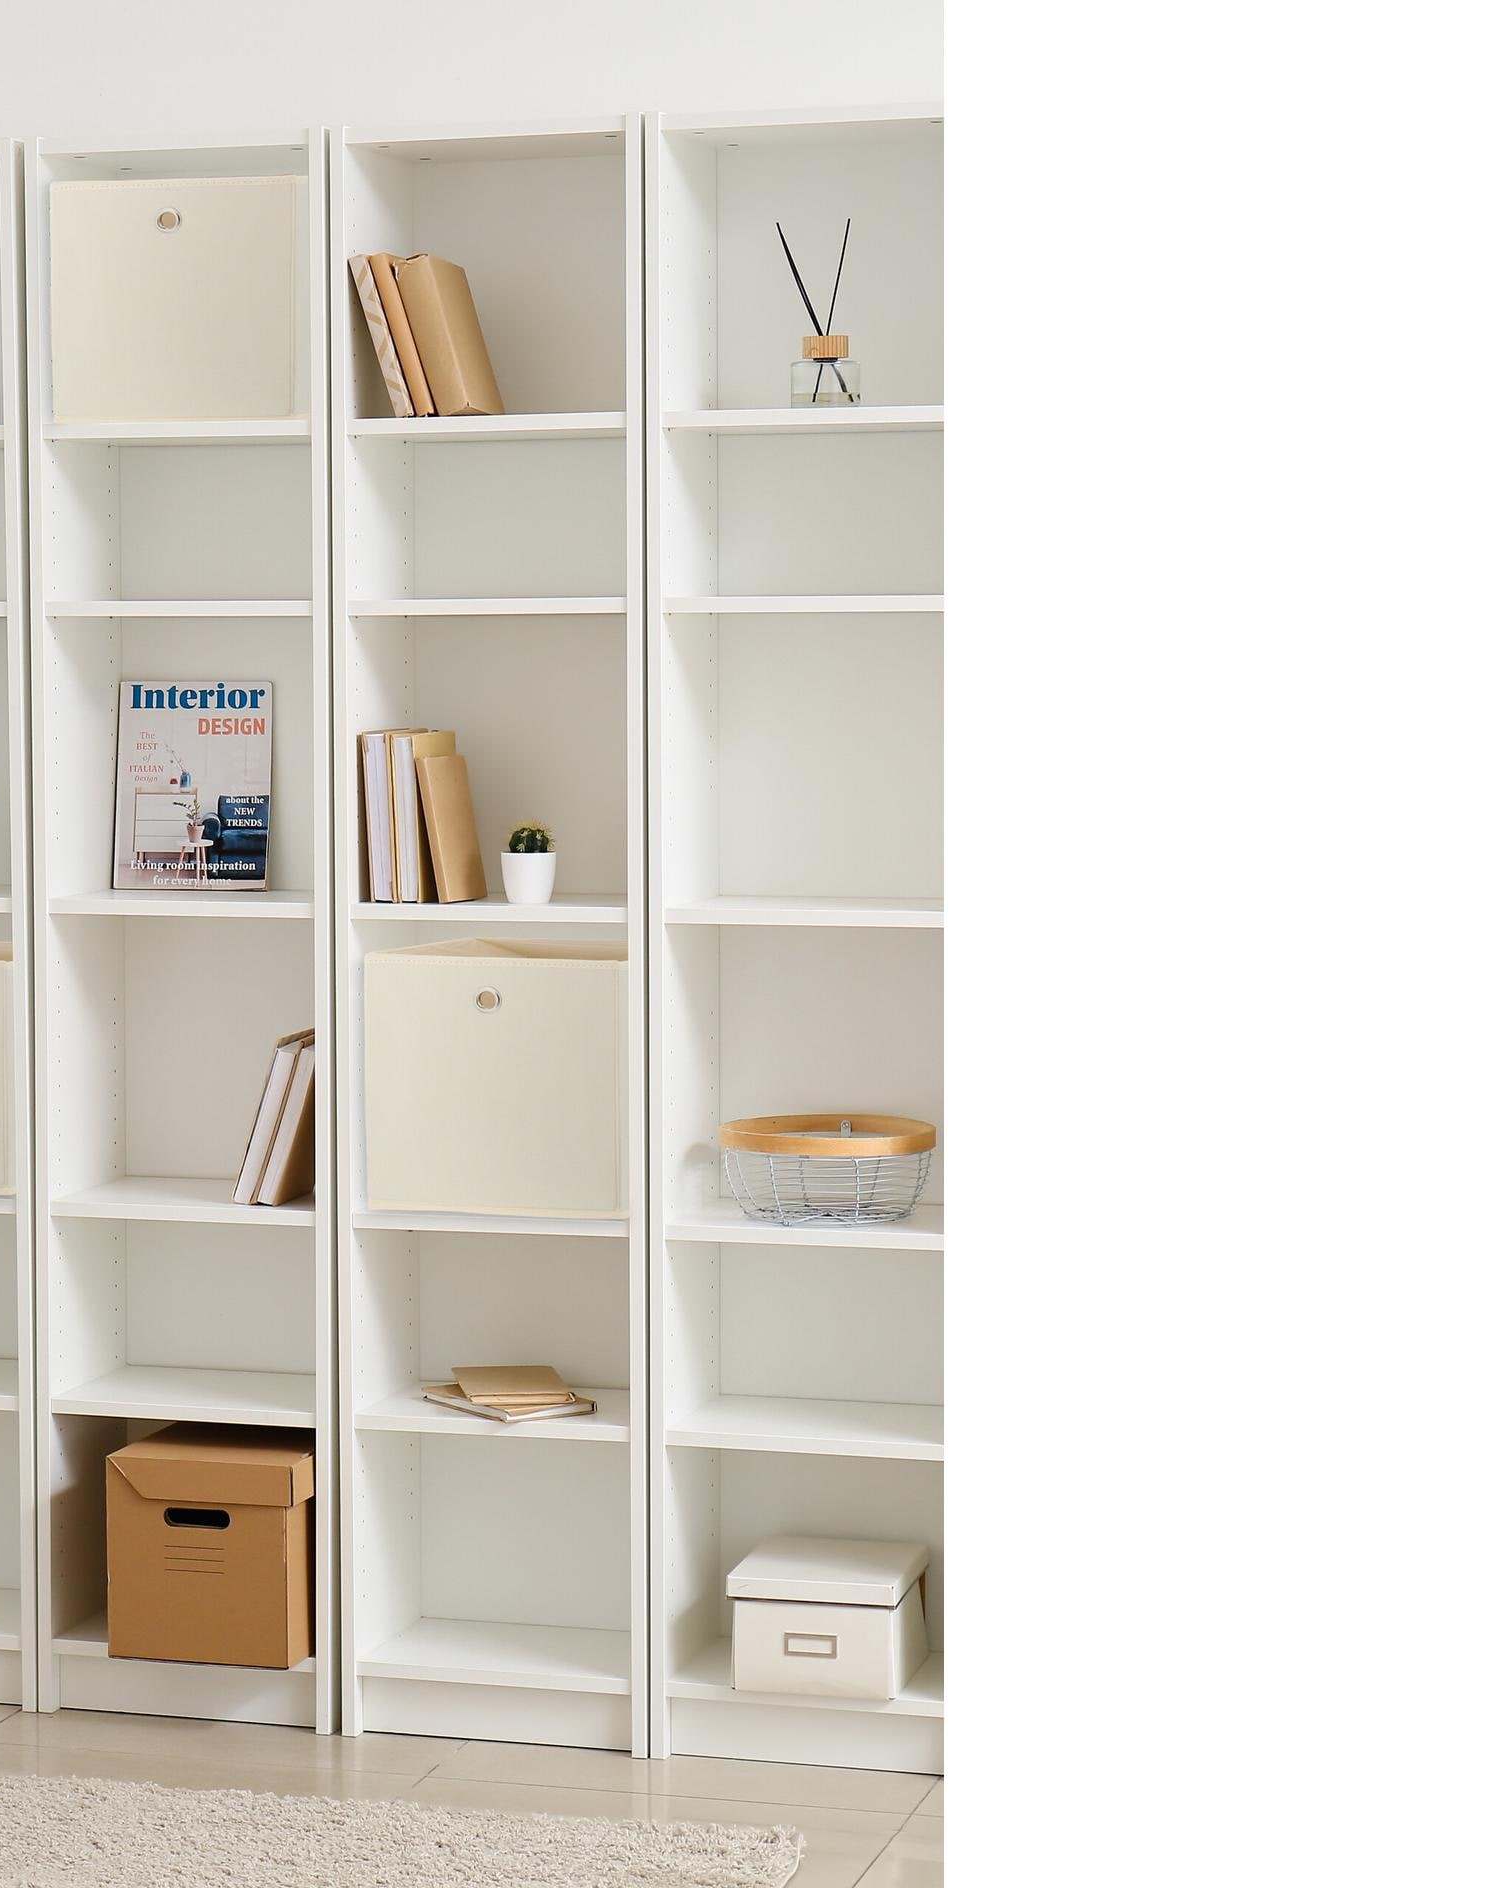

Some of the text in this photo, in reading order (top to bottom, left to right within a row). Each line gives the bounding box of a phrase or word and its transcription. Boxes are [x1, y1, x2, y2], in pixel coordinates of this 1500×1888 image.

[130, 683, 266, 709] Interior
[198, 718, 266, 735] DESIGN
[140, 731, 156, 739] The
[136, 742, 158, 750] BEST
[142, 754, 152, 762] of
[129, 765, 164, 773] ITALIAN
[225, 796, 265, 804] about the
[234, 807, 256, 816] NEW
[226, 818, 263, 827] TRENDS
[130, 860, 256, 873] Living room inspiration
[153, 875, 232, 888] for every home
